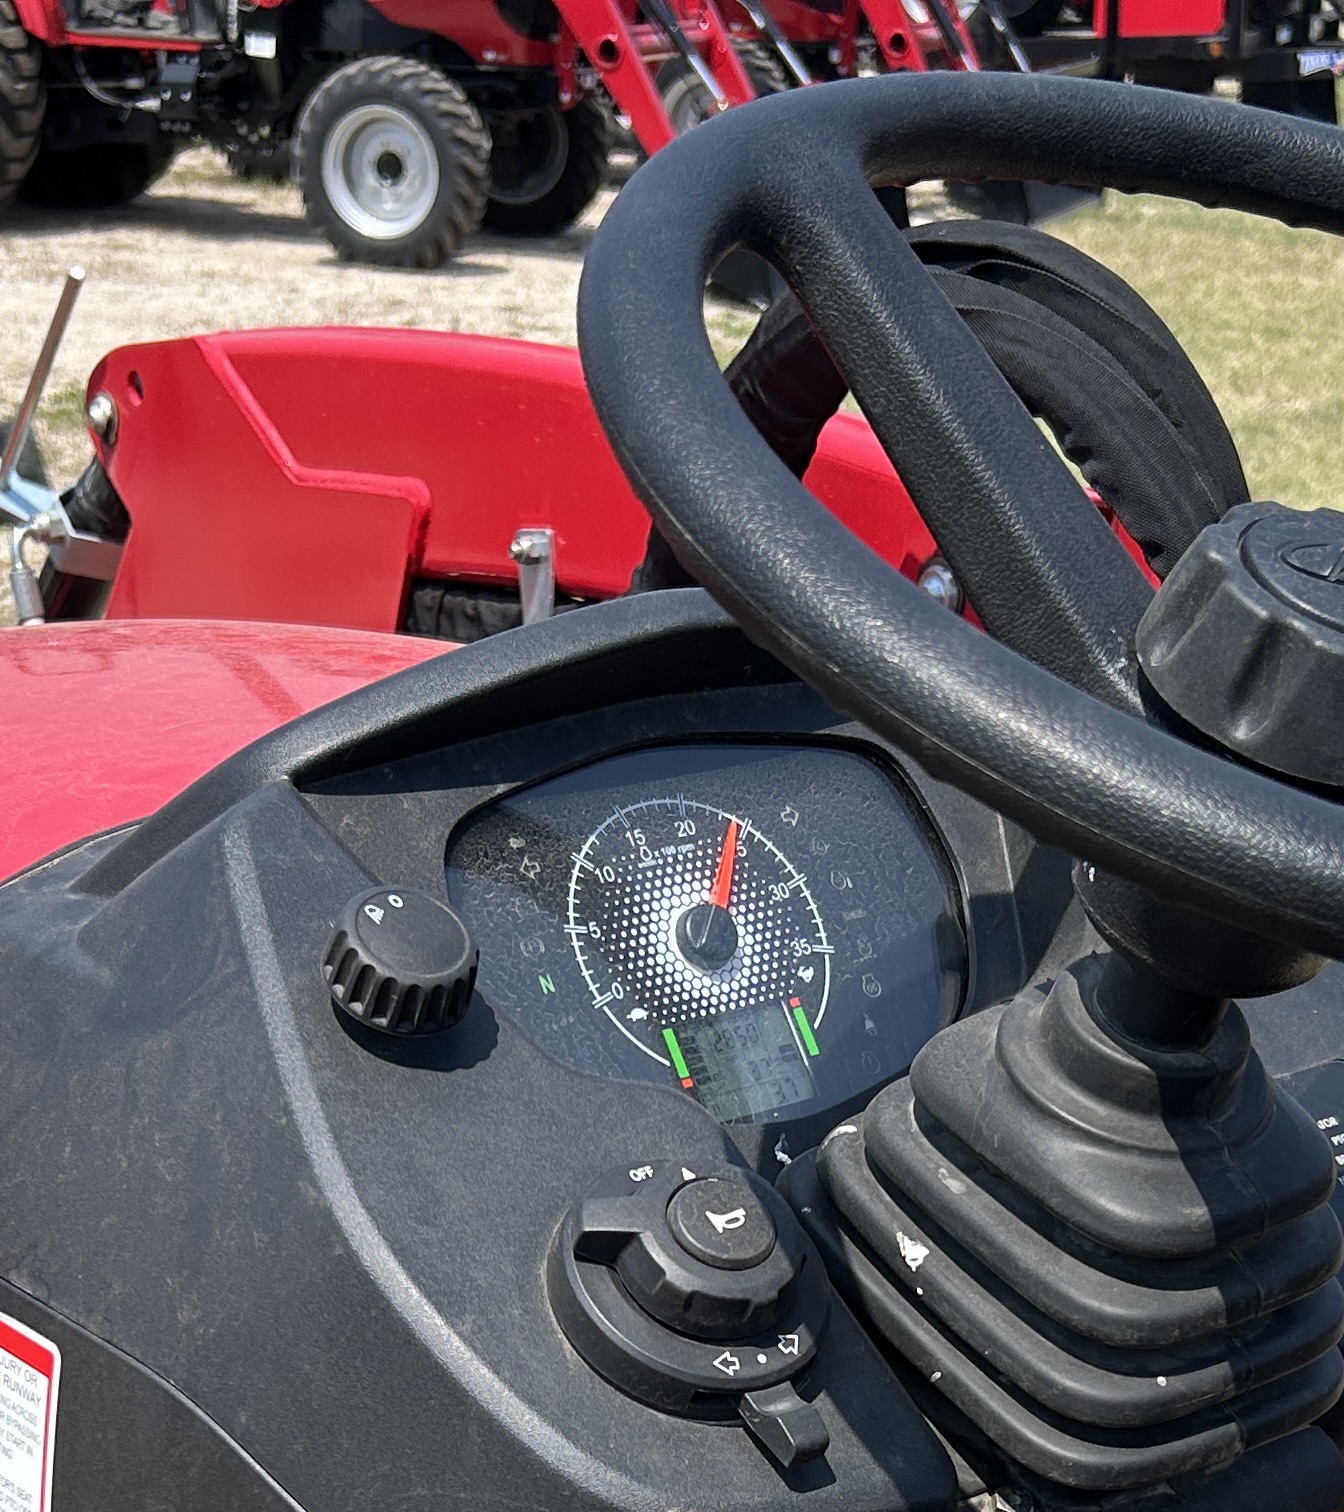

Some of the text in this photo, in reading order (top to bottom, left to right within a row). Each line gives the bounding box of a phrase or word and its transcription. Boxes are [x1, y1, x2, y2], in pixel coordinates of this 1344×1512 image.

[624, 828, 646, 848] 15
[674, 820, 696, 839] 20
[594, 866, 616, 885] 10
[768, 884, 790, 901] 30
[588, 921, 602, 939] 5
[791, 936, 812, 957] 35
[537, 974, 556, 995] N
[610, 981, 625, 1001] 0
[628, 1165, 654, 1183] OFF
[23, 1368, 37, 1388] OR
